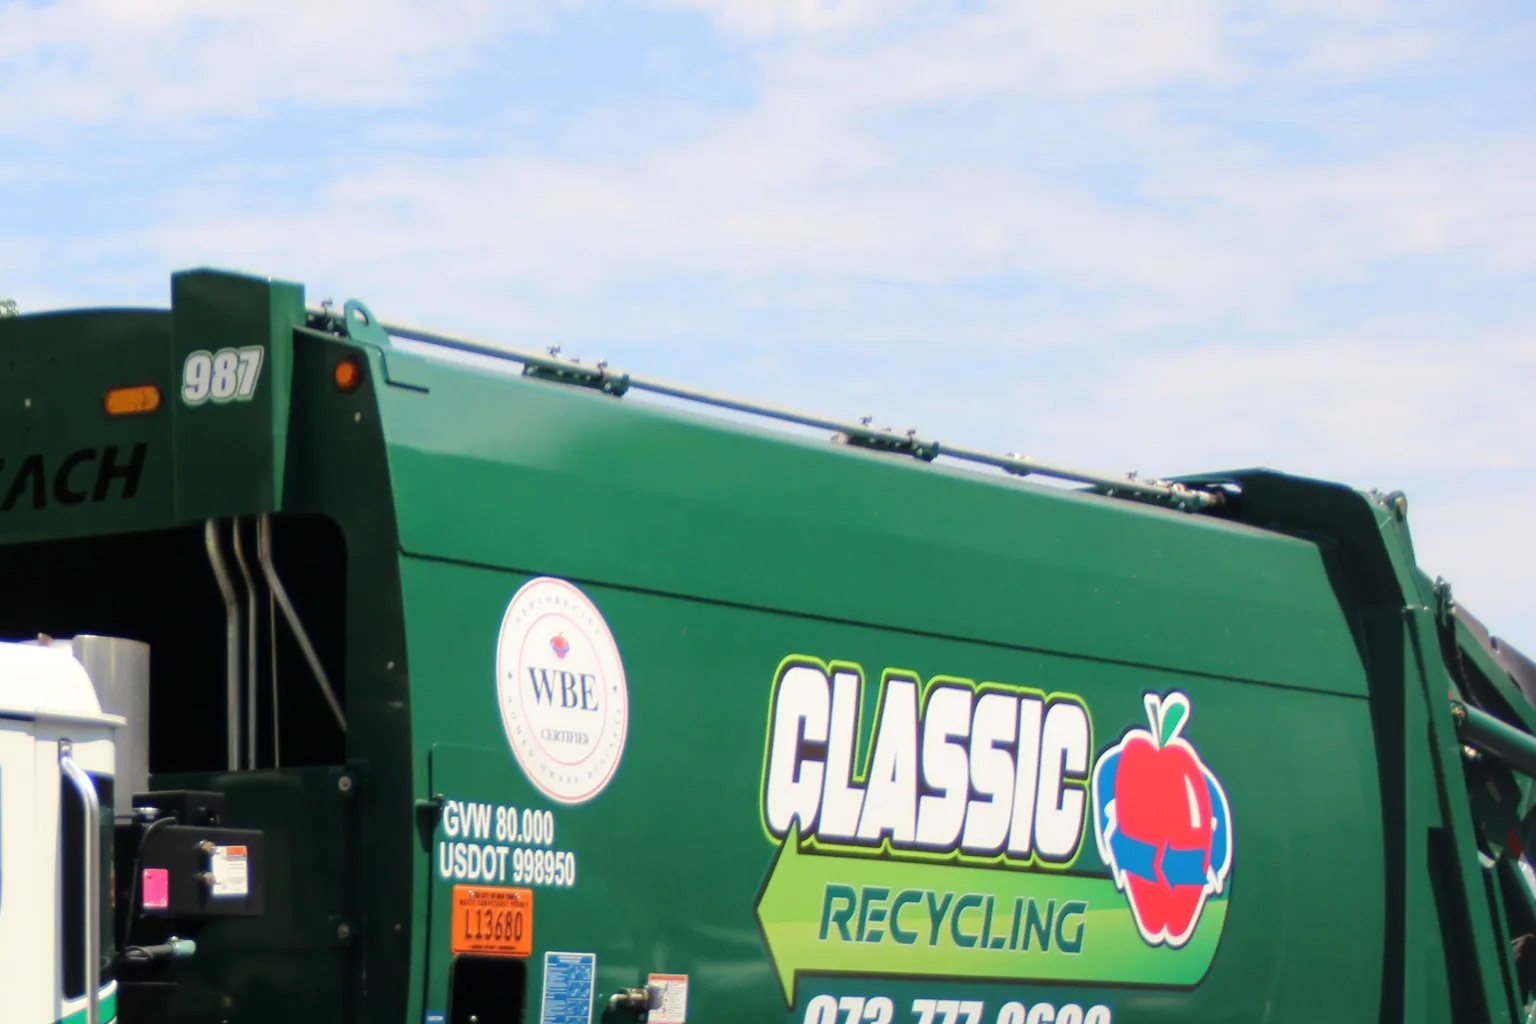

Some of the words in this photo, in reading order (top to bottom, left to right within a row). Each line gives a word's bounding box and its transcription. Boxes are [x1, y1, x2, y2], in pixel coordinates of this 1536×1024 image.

[182, 345, 264, 406] 987
[527, 667, 598, 711] WBE
[764, 660, 1094, 862] CLASSIC
[443, 800, 492, 839] GVW
[440, 841, 509, 881] USDOT
[513, 847, 576, 886] 998950
[818, 883, 1089, 957] RECYCLING
